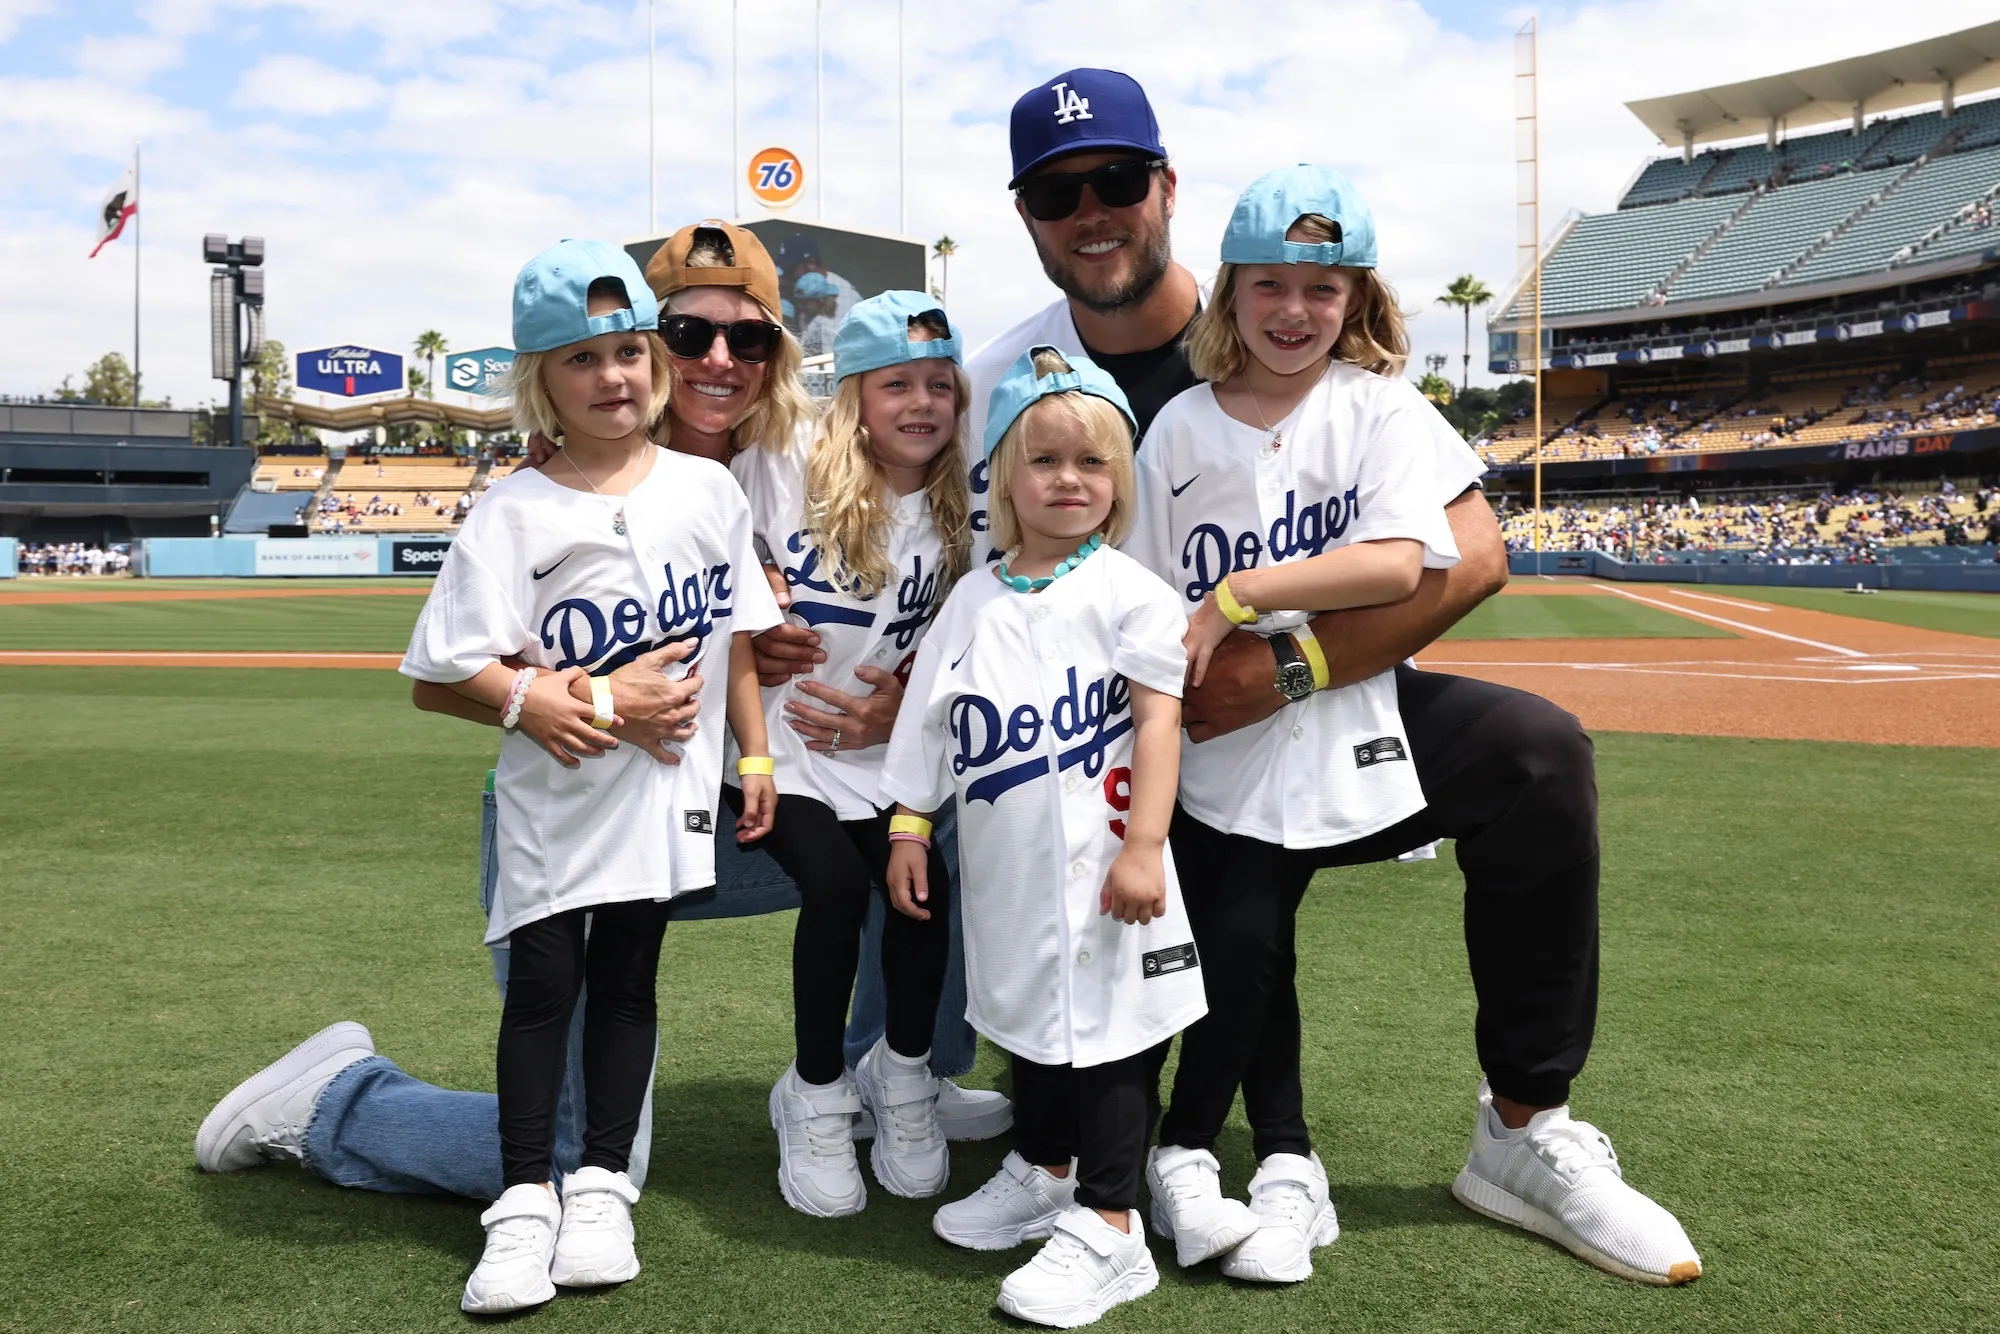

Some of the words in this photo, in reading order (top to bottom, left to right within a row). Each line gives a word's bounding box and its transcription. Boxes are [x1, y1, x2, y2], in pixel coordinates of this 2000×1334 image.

[1051, 82, 1093, 125] LA
[756, 159, 795, 190] 76
[317, 359, 382, 375] ULTRA
[370, 446, 414, 455] RAMS
[418, 446, 445, 455] DAY
[1844, 439, 1909, 459] RAMS
[1914, 435, 1955, 453] DAY
[261, 553, 288, 562] BANK
[291, 553, 303, 562] OF
[306, 553, 349, 562] AMERICA
